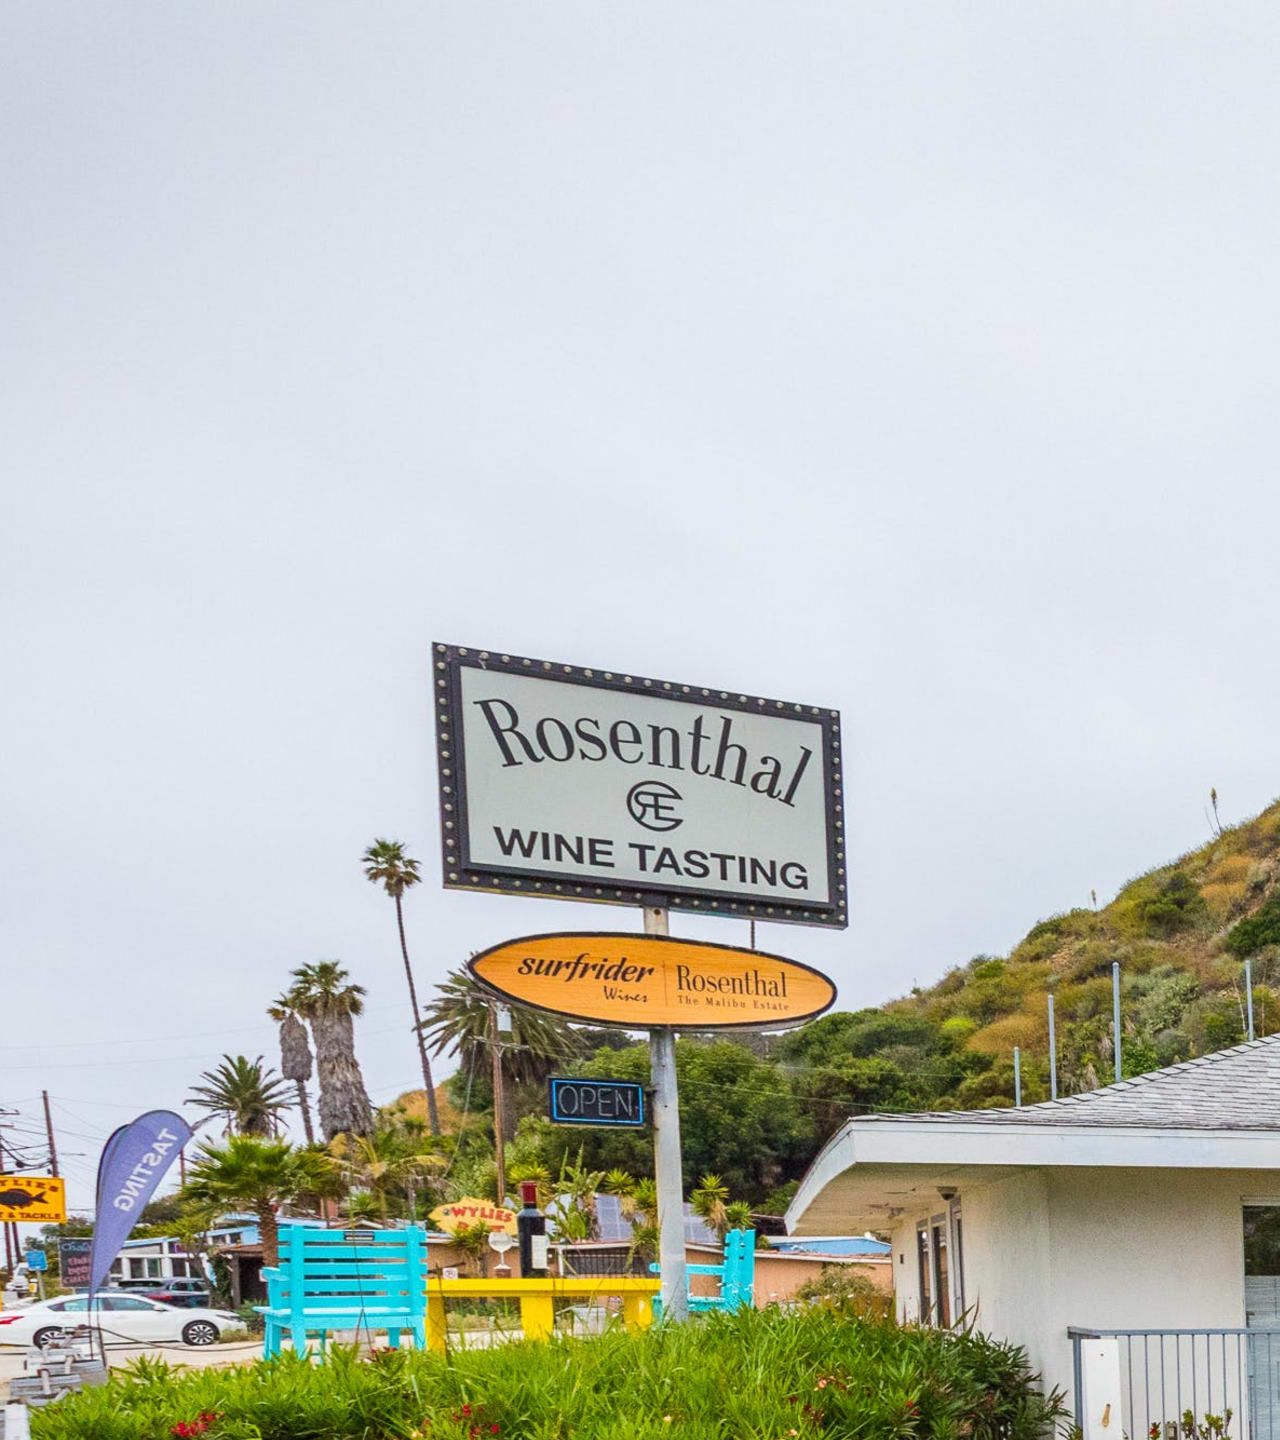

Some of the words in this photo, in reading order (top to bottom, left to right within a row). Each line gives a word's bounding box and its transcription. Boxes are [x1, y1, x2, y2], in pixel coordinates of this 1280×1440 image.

[473, 698, 813, 808] Rosenthal
[493, 826, 615, 868] WINE
[629, 842, 809, 890] TASTING
[517, 953, 655, 982] surfrider
[676, 965, 787, 997] Rosenthal
[603, 985, 648, 1003] Wines
[677, 995, 699, 1005] The
[706, 997, 746, 1009] Malibu
[753, 1000, 789, 1010] Estate
[558, 1086, 632, 1117] OPEN
[19, 1212, 61, 1220] TACKLE
[451, 1206, 513, 1223] WYLIES
